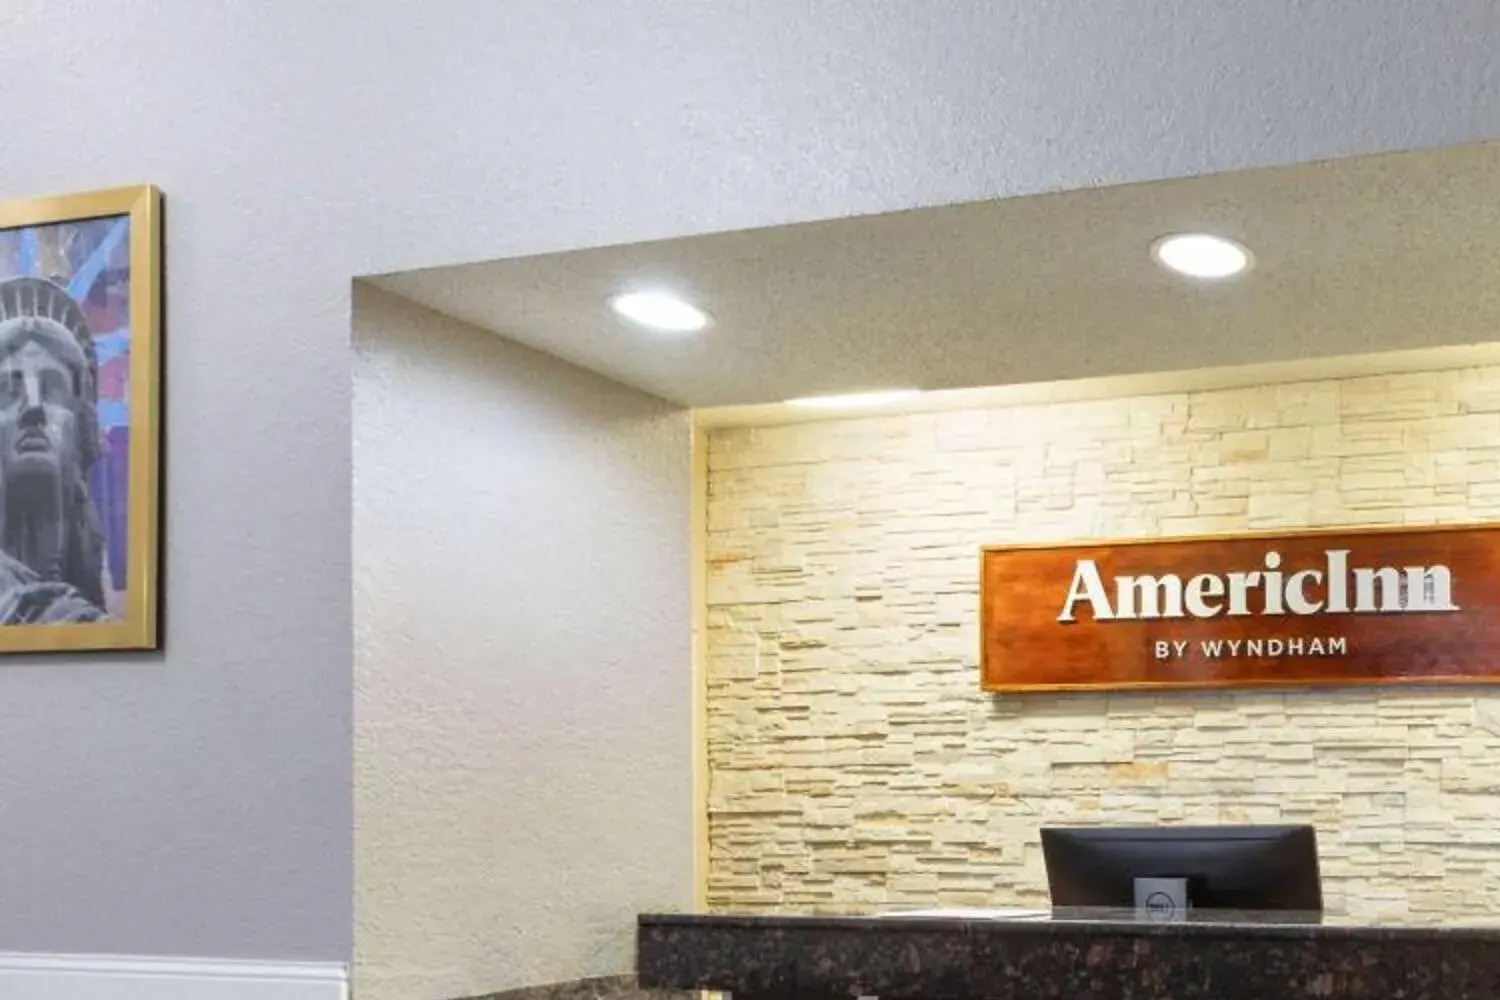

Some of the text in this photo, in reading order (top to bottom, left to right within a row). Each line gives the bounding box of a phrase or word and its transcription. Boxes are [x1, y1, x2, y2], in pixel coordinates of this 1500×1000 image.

[1056, 548, 1461, 623] AmericInn
[1155, 637, 1347, 658] BY WYNDHAM
